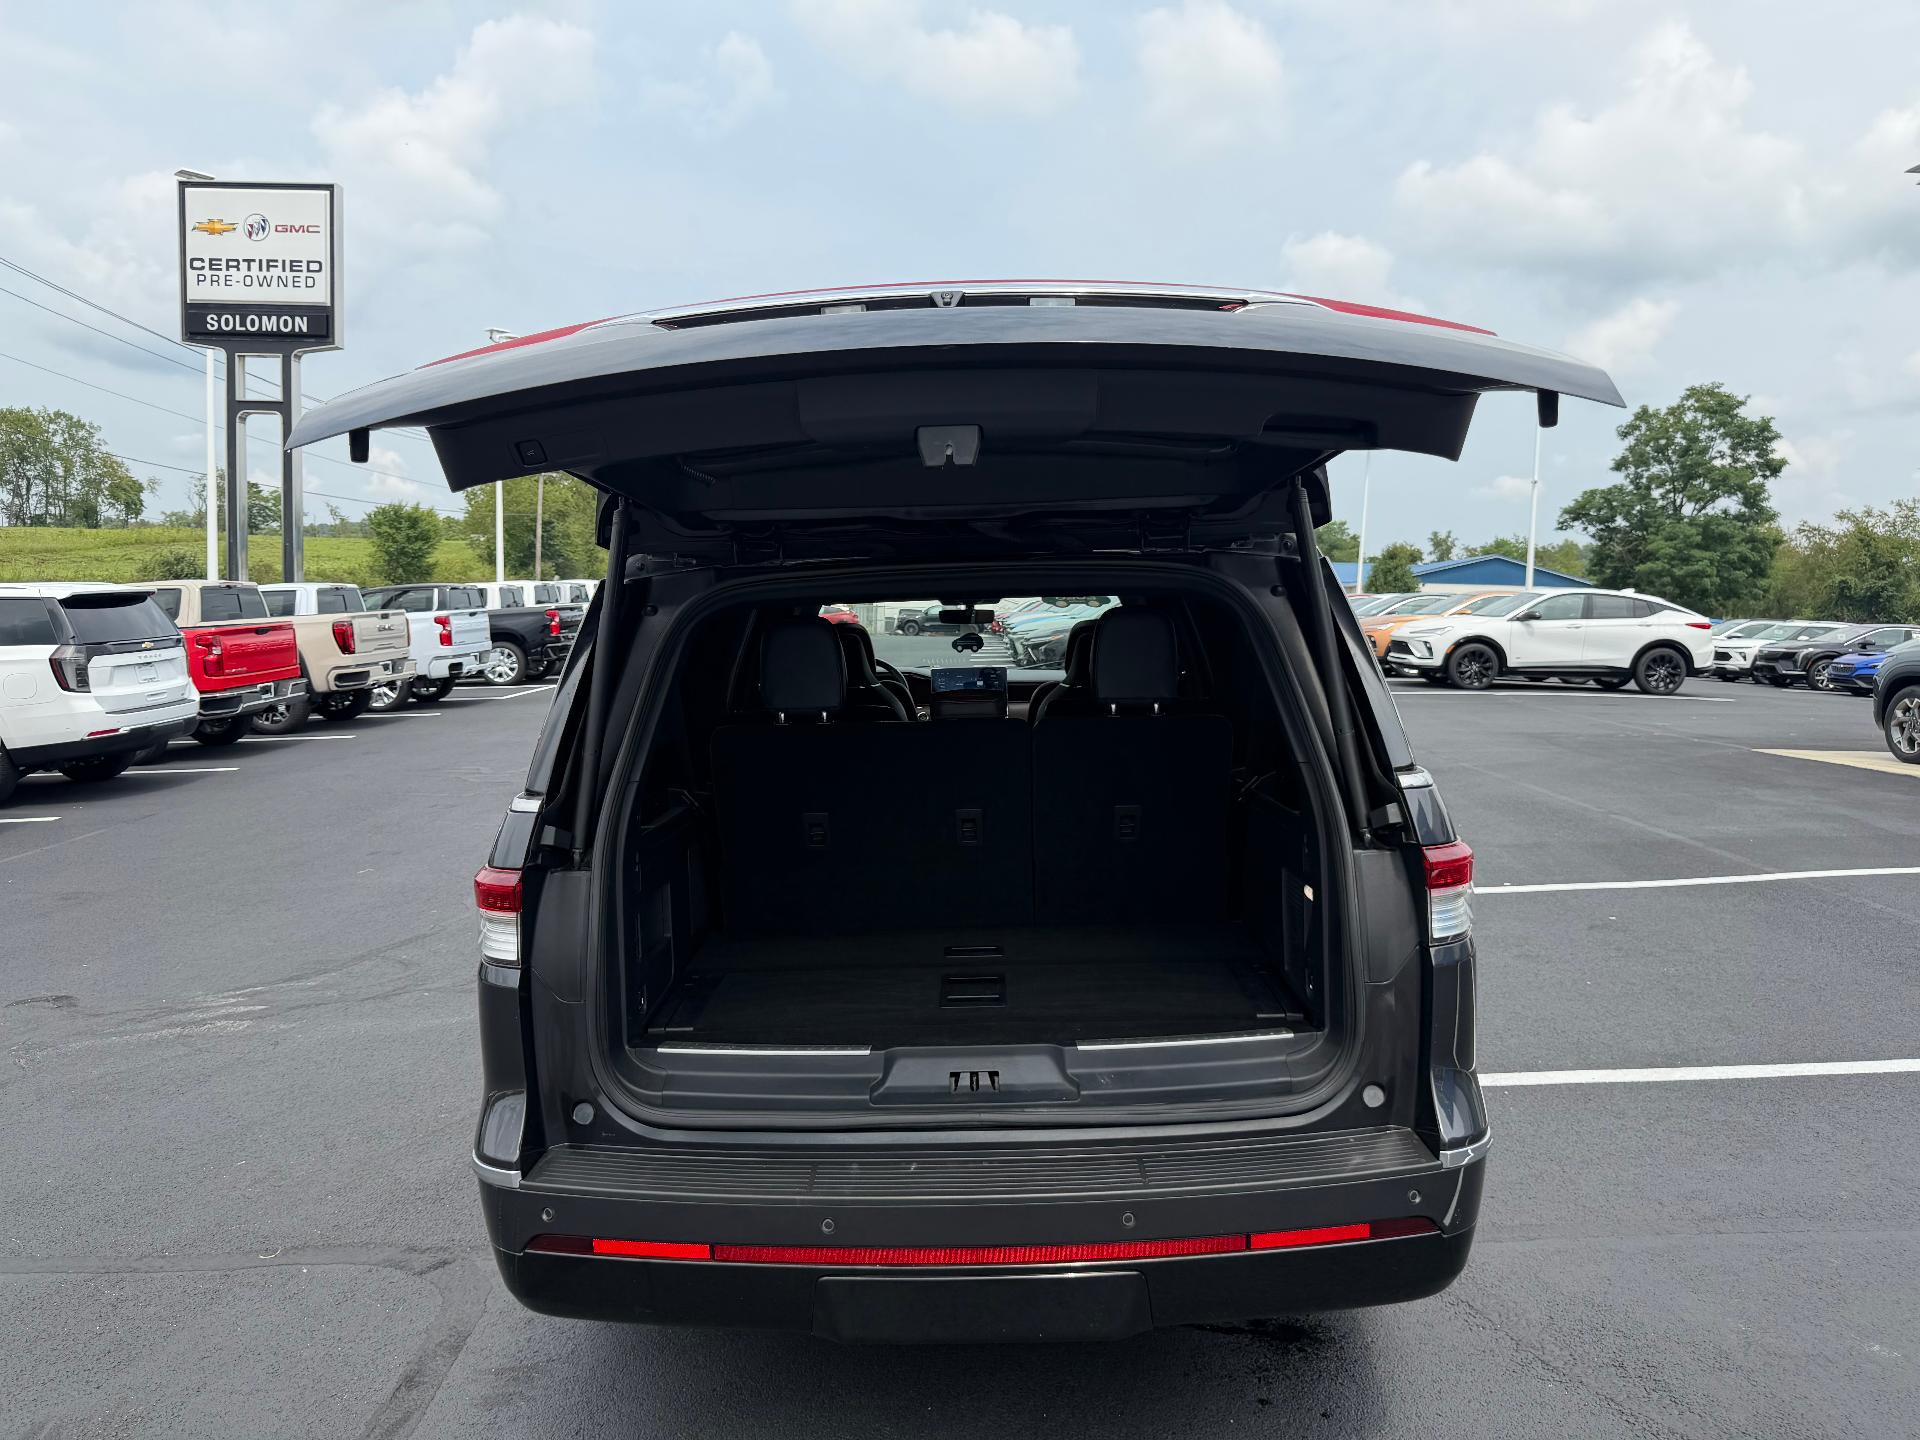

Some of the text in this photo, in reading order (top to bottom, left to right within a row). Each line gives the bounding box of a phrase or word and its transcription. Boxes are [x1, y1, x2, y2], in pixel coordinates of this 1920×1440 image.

[274, 224, 321, 234] GMC
[189, 257, 323, 273] CERTIFIED
[196, 274, 316, 288] PRE-OWNED
[206, 314, 308, 333] SOLOMON
